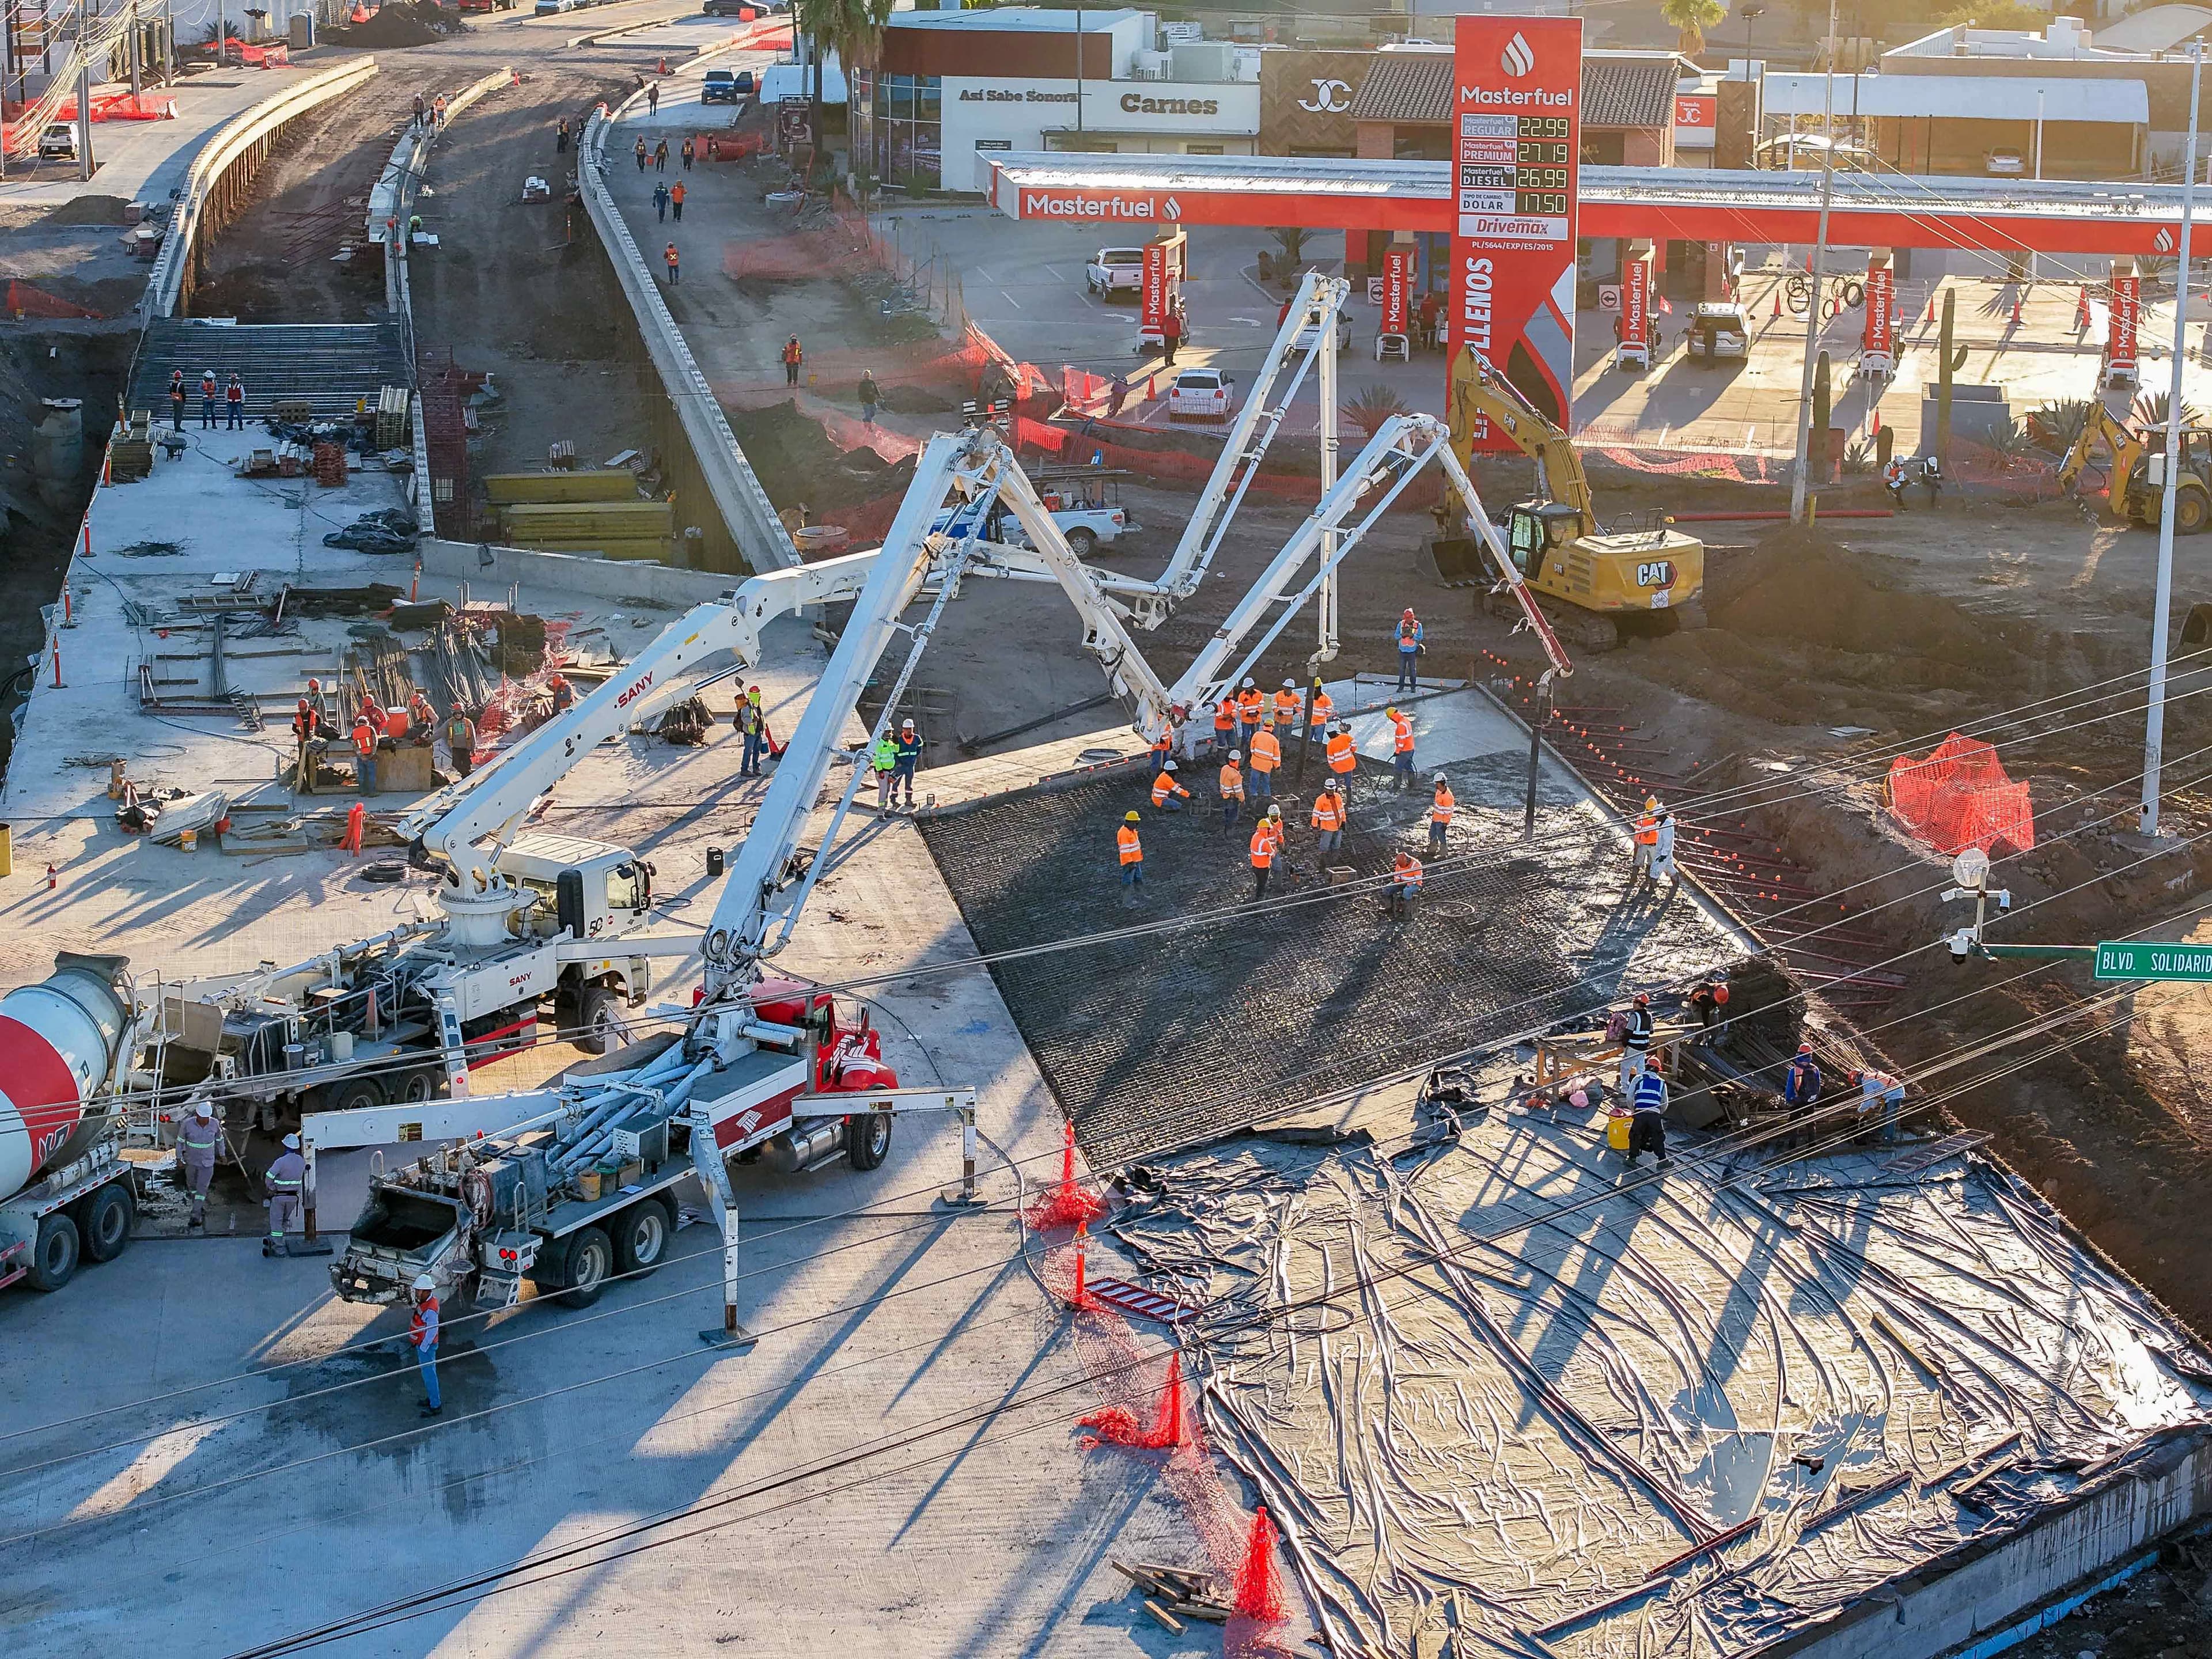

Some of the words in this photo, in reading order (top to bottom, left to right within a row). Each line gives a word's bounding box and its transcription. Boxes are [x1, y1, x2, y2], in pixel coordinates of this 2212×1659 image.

[959, 89, 984, 101] Así
[986, 90, 1023, 101] Sabe
[1026, 90, 1079, 103] Sonora
[1120, 93, 1218, 115] Carnes
[1461, 86, 1572, 106] Masterfuel
[1464, 117, 1503, 125] Masterfuel
[1464, 126, 1512, 136] REGULAR
[1519, 118, 1568, 138] 22.99
[1464, 142, 1503, 150] Masterfuel
[1464, 150, 1512, 161] PREMIUM
[1518, 143, 1567, 163] 27.19
[1463, 168, 1502, 176] Masterfuel
[1463, 176, 1506, 186] DIESEL
[1518, 168, 1567, 188] 26.99
[1027, 194, 1154, 218] Masterfuel
[1463, 200, 1503, 210] DOLAR
[1525, 194, 1566, 214] 17.50
[1476, 218, 1549, 235] Drivemax
[1472, 241, 1554, 251] PL/5644/EXP/ES/2015
[1149, 248, 1160, 315] Masterfuel
[1389, 255, 1401, 322] Masterfuel
[1464, 257, 1494, 350] LLENOS
[1629, 263, 1642, 329] Masterfuel
[1873, 271, 1886, 338] Masterfuel
[2118, 279, 2132, 348] Masterfuel
[1504, 412, 1516, 431] CAT
[1637, 562, 1668, 586] CAT
[618, 671, 653, 709] SANY
[2103, 952, 2136, 971] BLVD.
[509, 972, 532, 987] SANY
